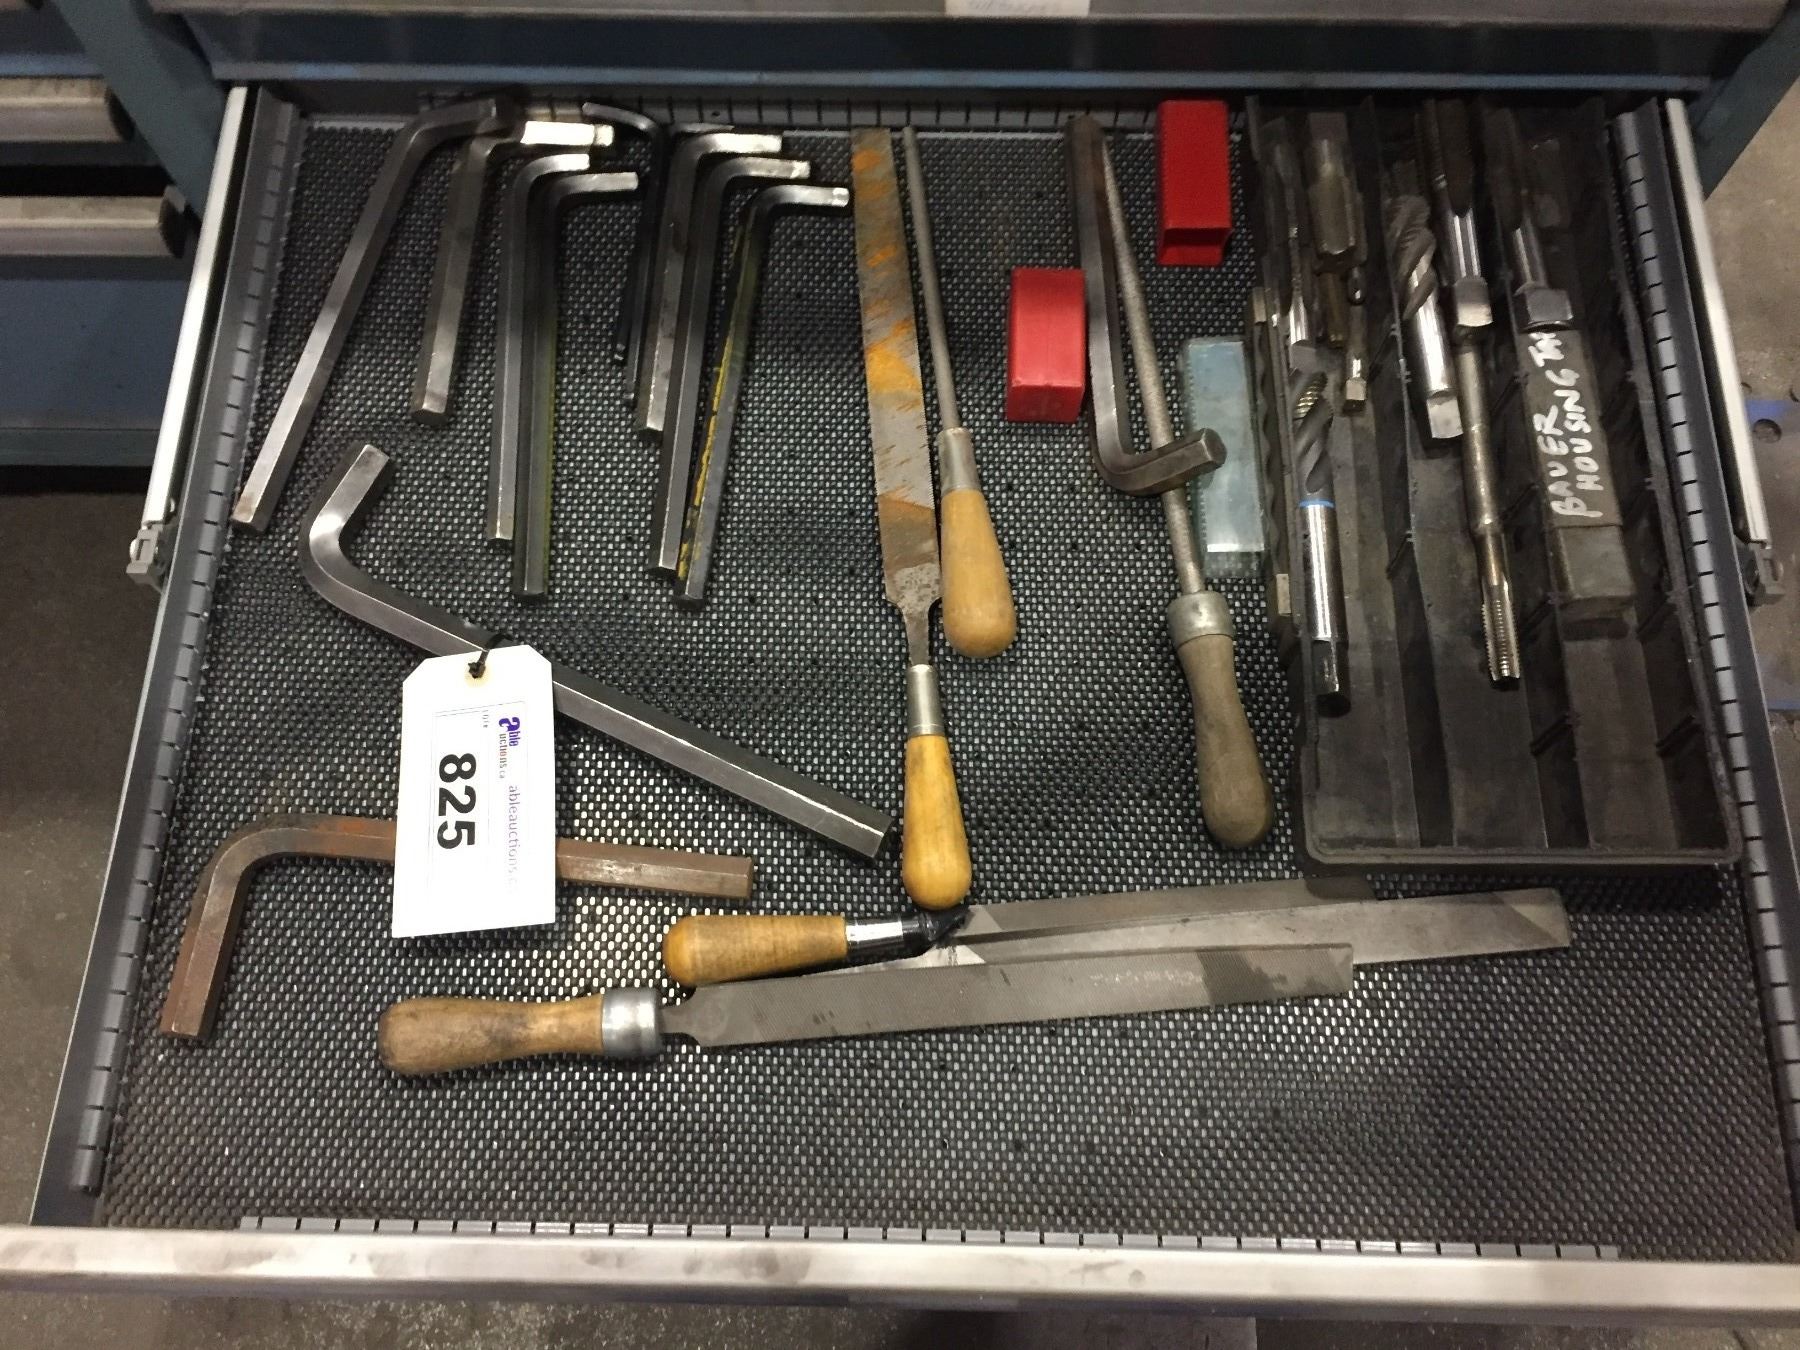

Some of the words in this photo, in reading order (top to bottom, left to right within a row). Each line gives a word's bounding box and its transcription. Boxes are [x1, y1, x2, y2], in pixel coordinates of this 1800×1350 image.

[1533, 404, 1604, 518] BAUER
[1545, 368, 1604, 491] HOUSING
[437, 753, 477, 849] 825
[508, 785, 521, 892] ableauctions.c
